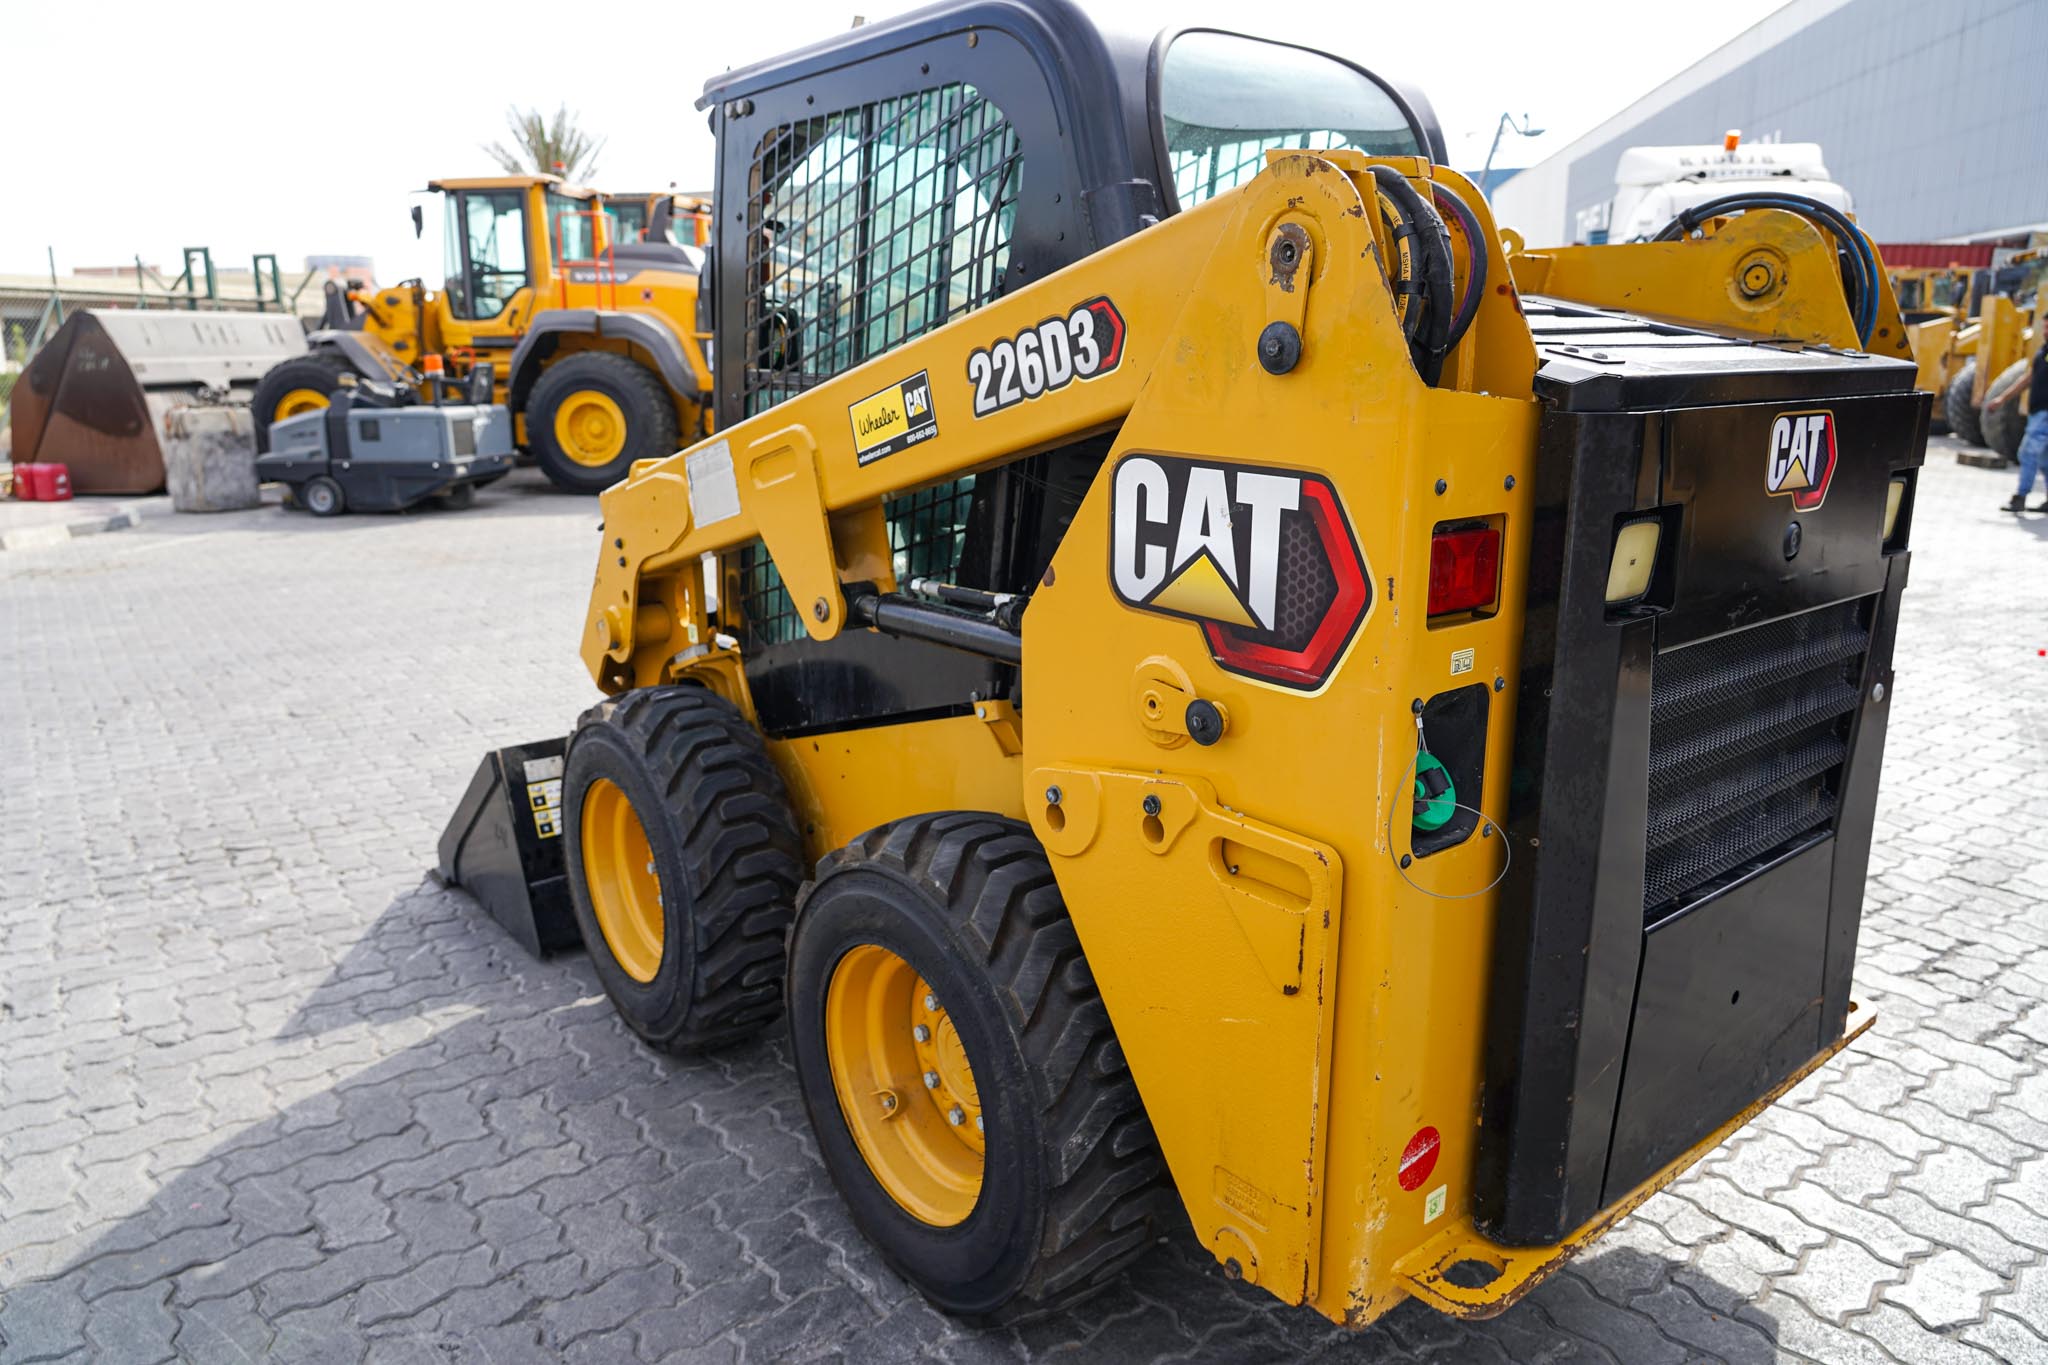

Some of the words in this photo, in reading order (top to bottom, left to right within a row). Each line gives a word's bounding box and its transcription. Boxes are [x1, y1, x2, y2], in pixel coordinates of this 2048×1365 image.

[1402, 252, 1410, 275] MSHA
[969, 309, 1100, 414] 226D3
[858, 407, 900, 437] Wheeler
[904, 385, 928, 418] CAT
[1767, 415, 1826, 492] CAT
[1113, 457, 1301, 632] CAT
